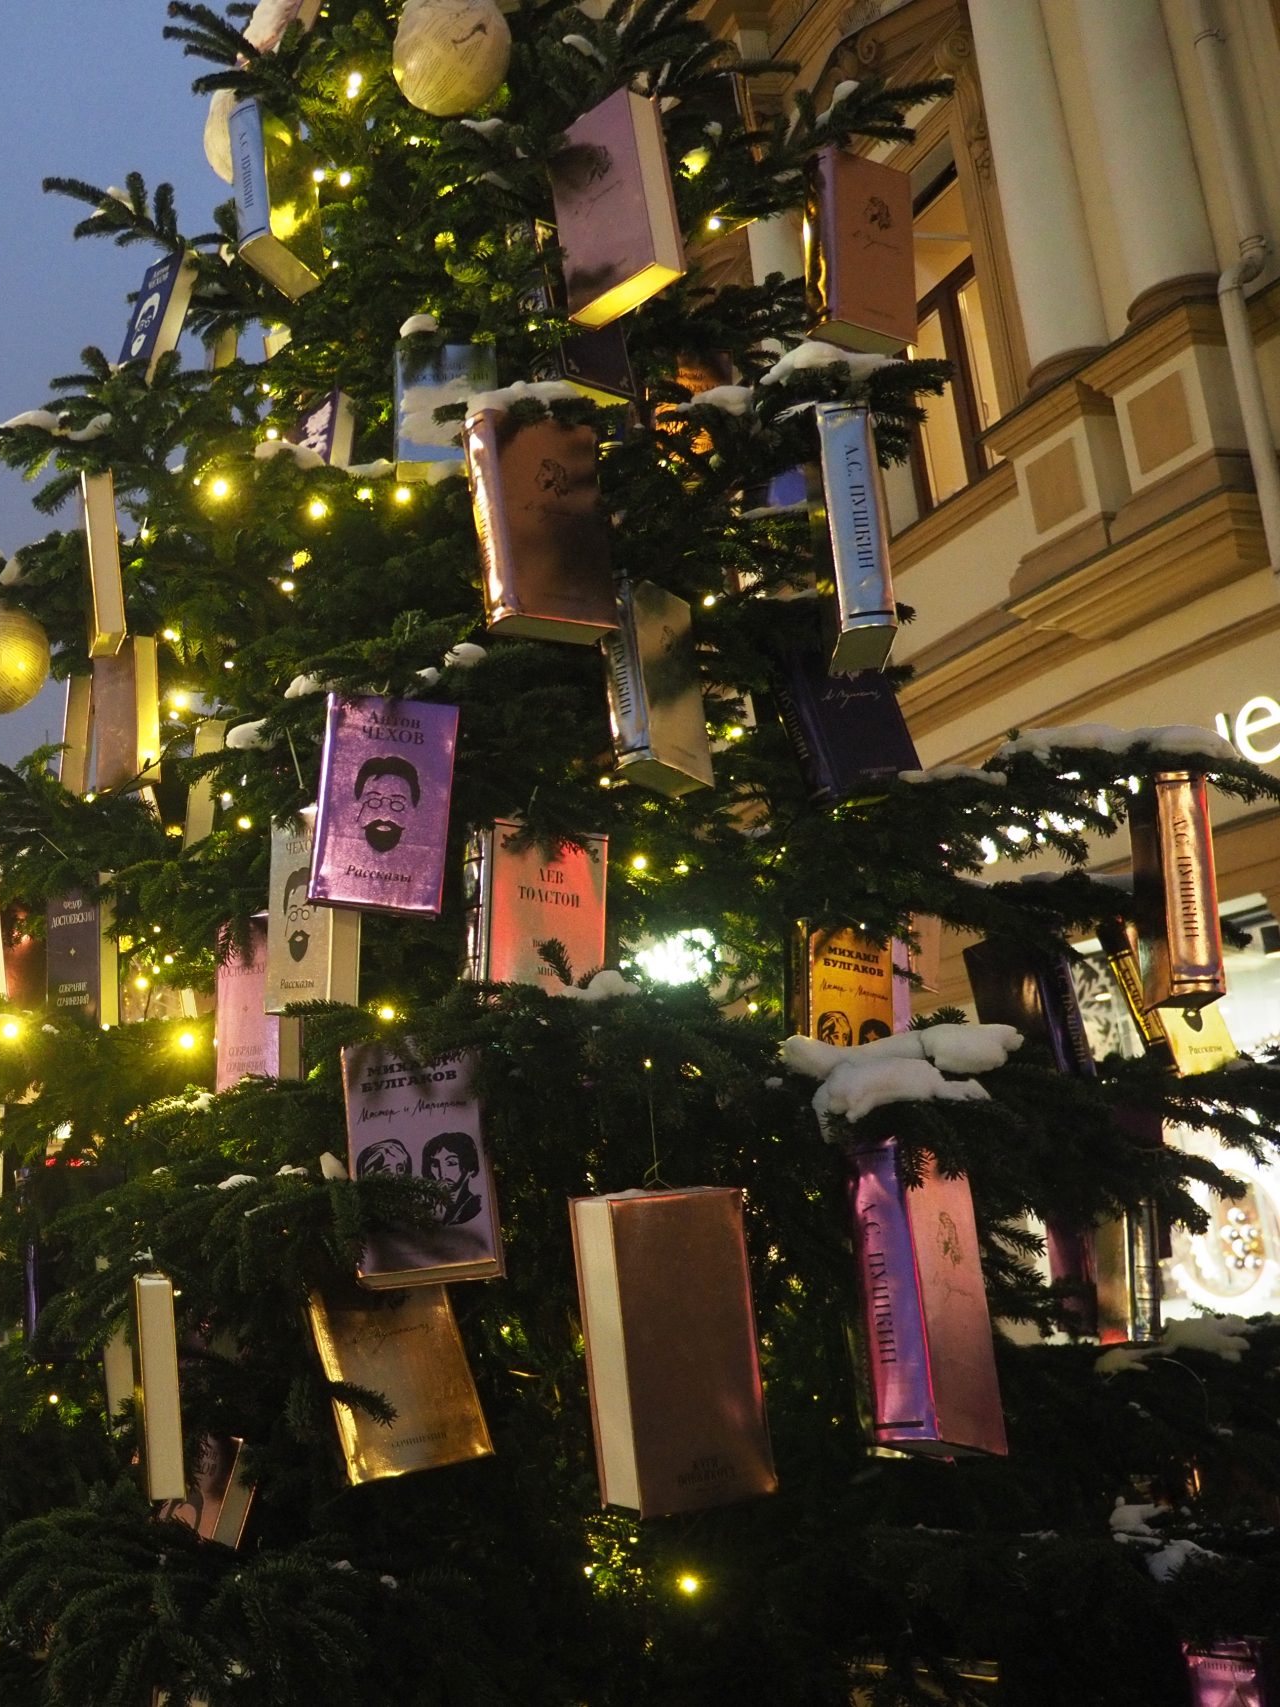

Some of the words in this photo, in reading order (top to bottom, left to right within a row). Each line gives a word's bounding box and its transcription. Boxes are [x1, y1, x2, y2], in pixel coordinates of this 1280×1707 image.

[850, 485, 875, 569] ПУШКИН
[613, 644, 632, 716] ПУШКИН
[369, 711, 420, 729] Антон
[363, 725, 424, 745] ЧЕХОВ
[285, 840, 312, 855] ЧЕХО
[345, 864, 413, 883] Рассказы
[538, 868, 564, 883] ЛЕВ
[518, 885, 580, 908] ТОЛСТОЙ
[1177, 856, 1200, 937] ПУШКИН
[51, 911, 95, 929] ДОСТОЕВСКИЙ
[828, 946, 879, 963] МИХАИЛ
[823, 958, 884, 977] БУЛГАКОВ
[280, 978, 315, 989] Рассказы
[361, 1070, 457, 1093] БУЛГАКОВ
[868, 1252, 897, 1365] ПУШКИН
